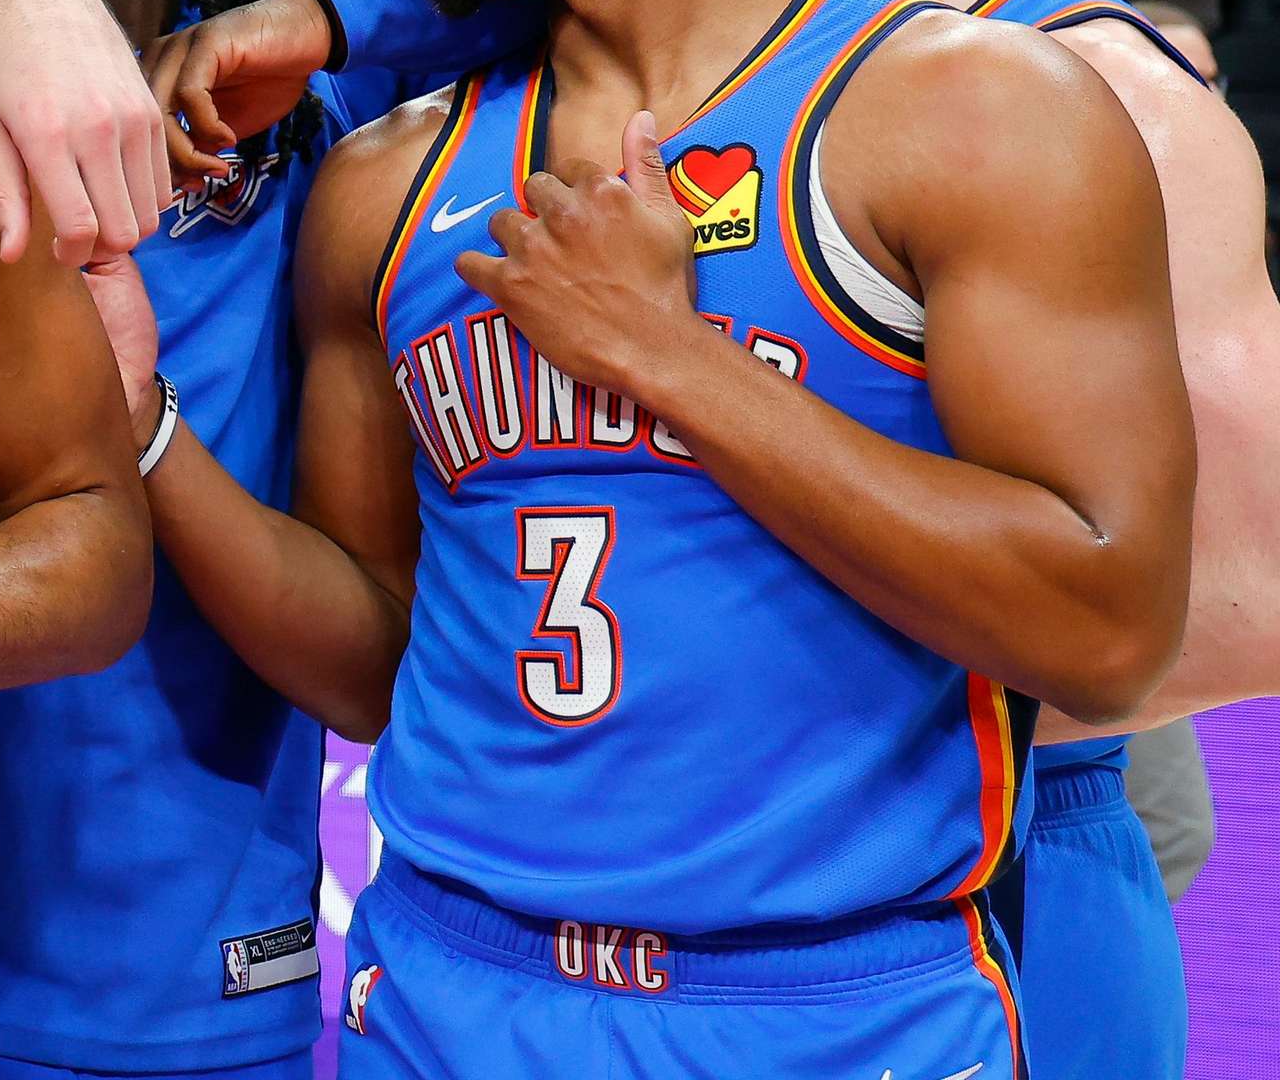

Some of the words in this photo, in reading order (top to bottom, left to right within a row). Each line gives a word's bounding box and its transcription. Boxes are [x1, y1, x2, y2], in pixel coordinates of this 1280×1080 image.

[515, 505, 623, 728] 3
[249, 943, 264, 958] XL
[553, 919, 671, 992] OKC
